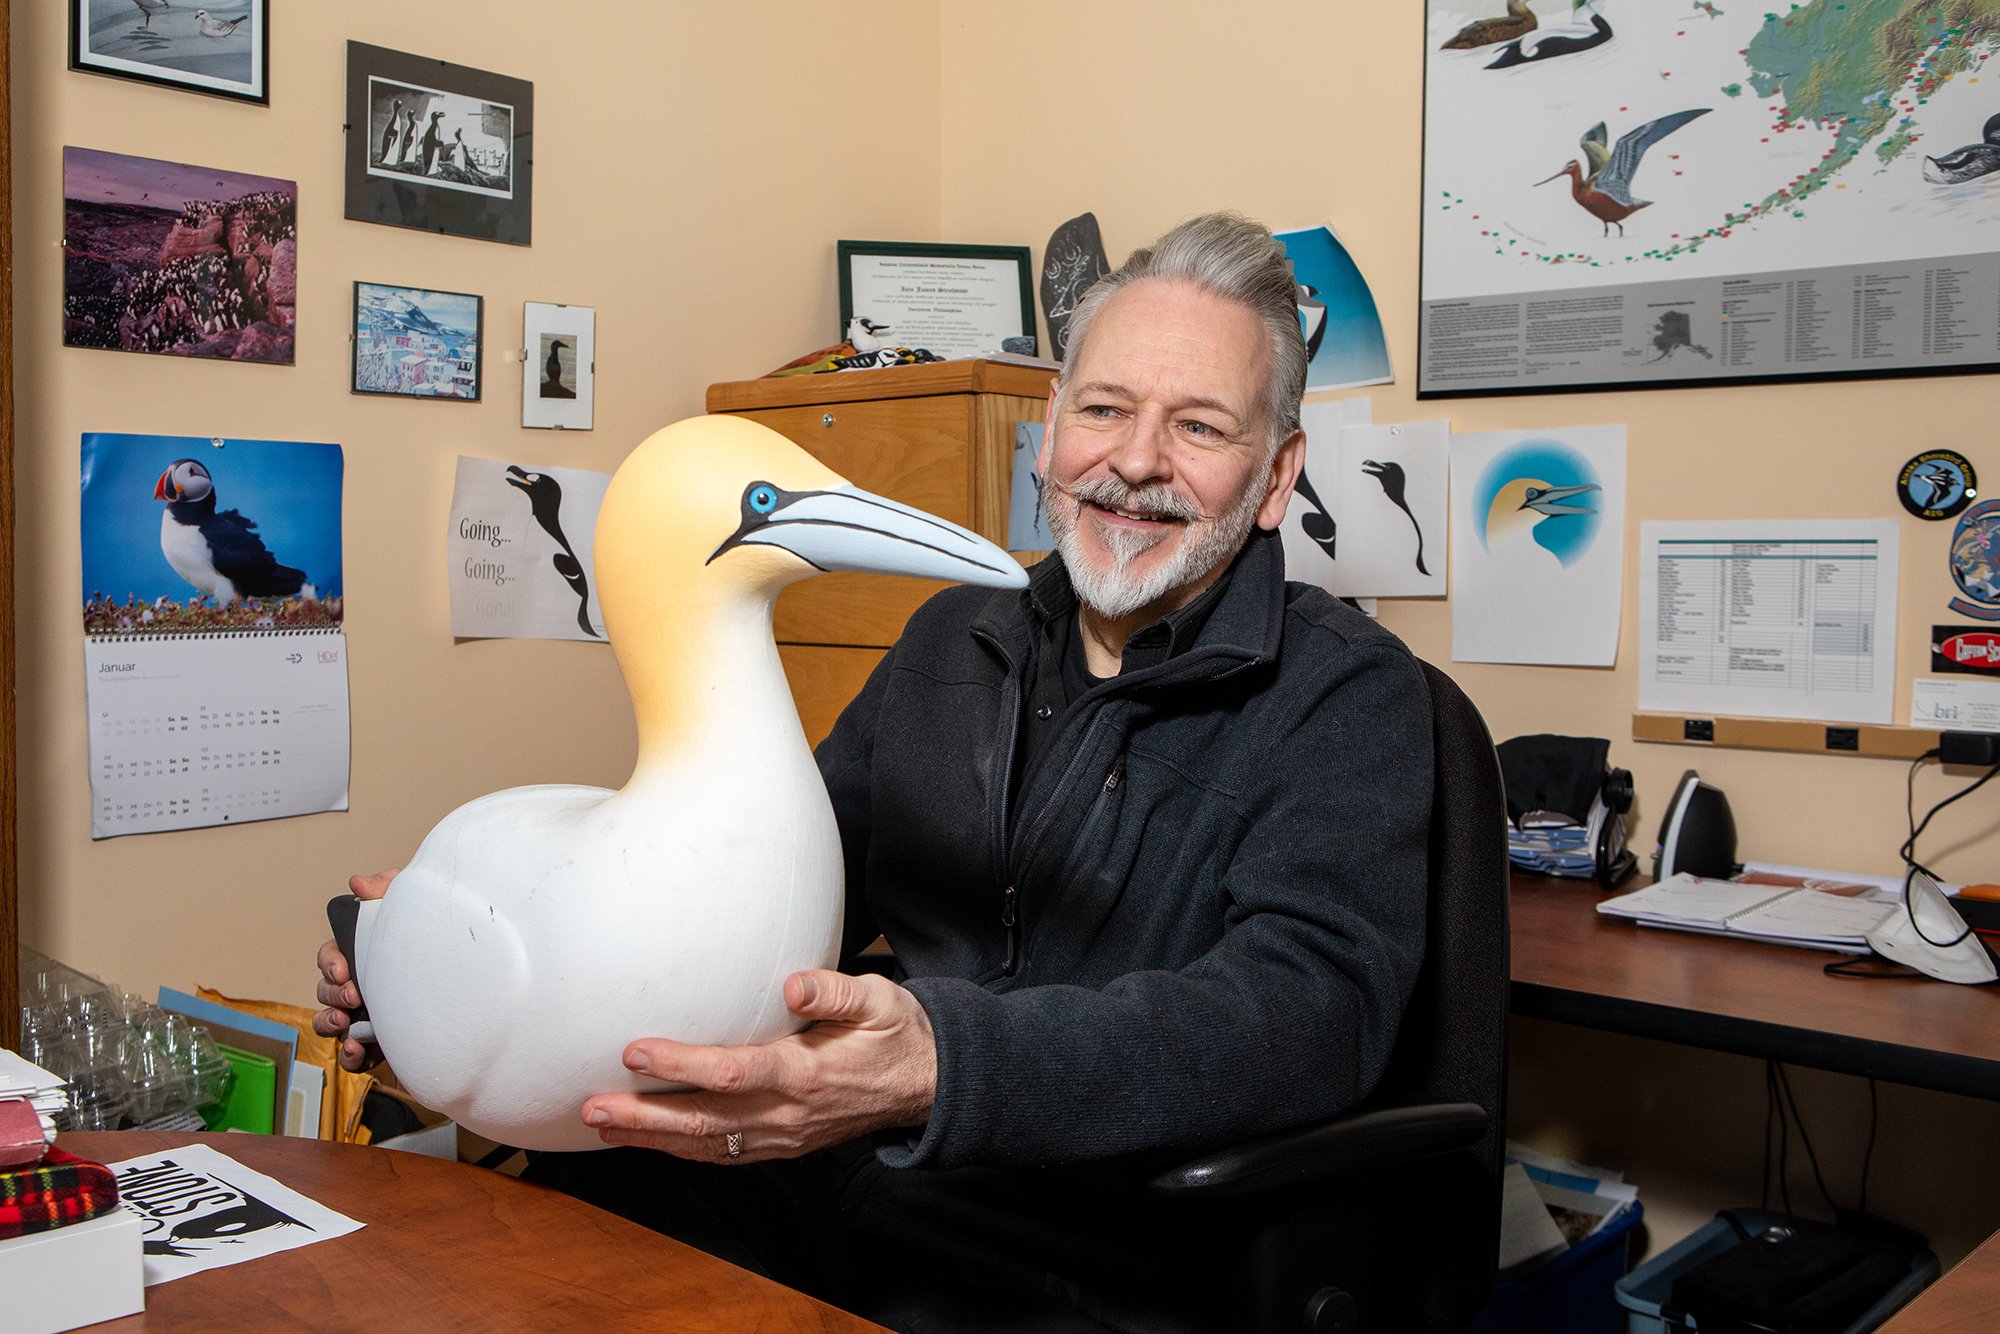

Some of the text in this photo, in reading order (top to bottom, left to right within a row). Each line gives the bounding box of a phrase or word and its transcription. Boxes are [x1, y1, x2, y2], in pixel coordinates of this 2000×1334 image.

[460, 517, 511, 548] Going...
[464, 556, 515, 586] Going...
[98, 663, 136, 673] Januar
[1934, 702, 1958, 719] bri
